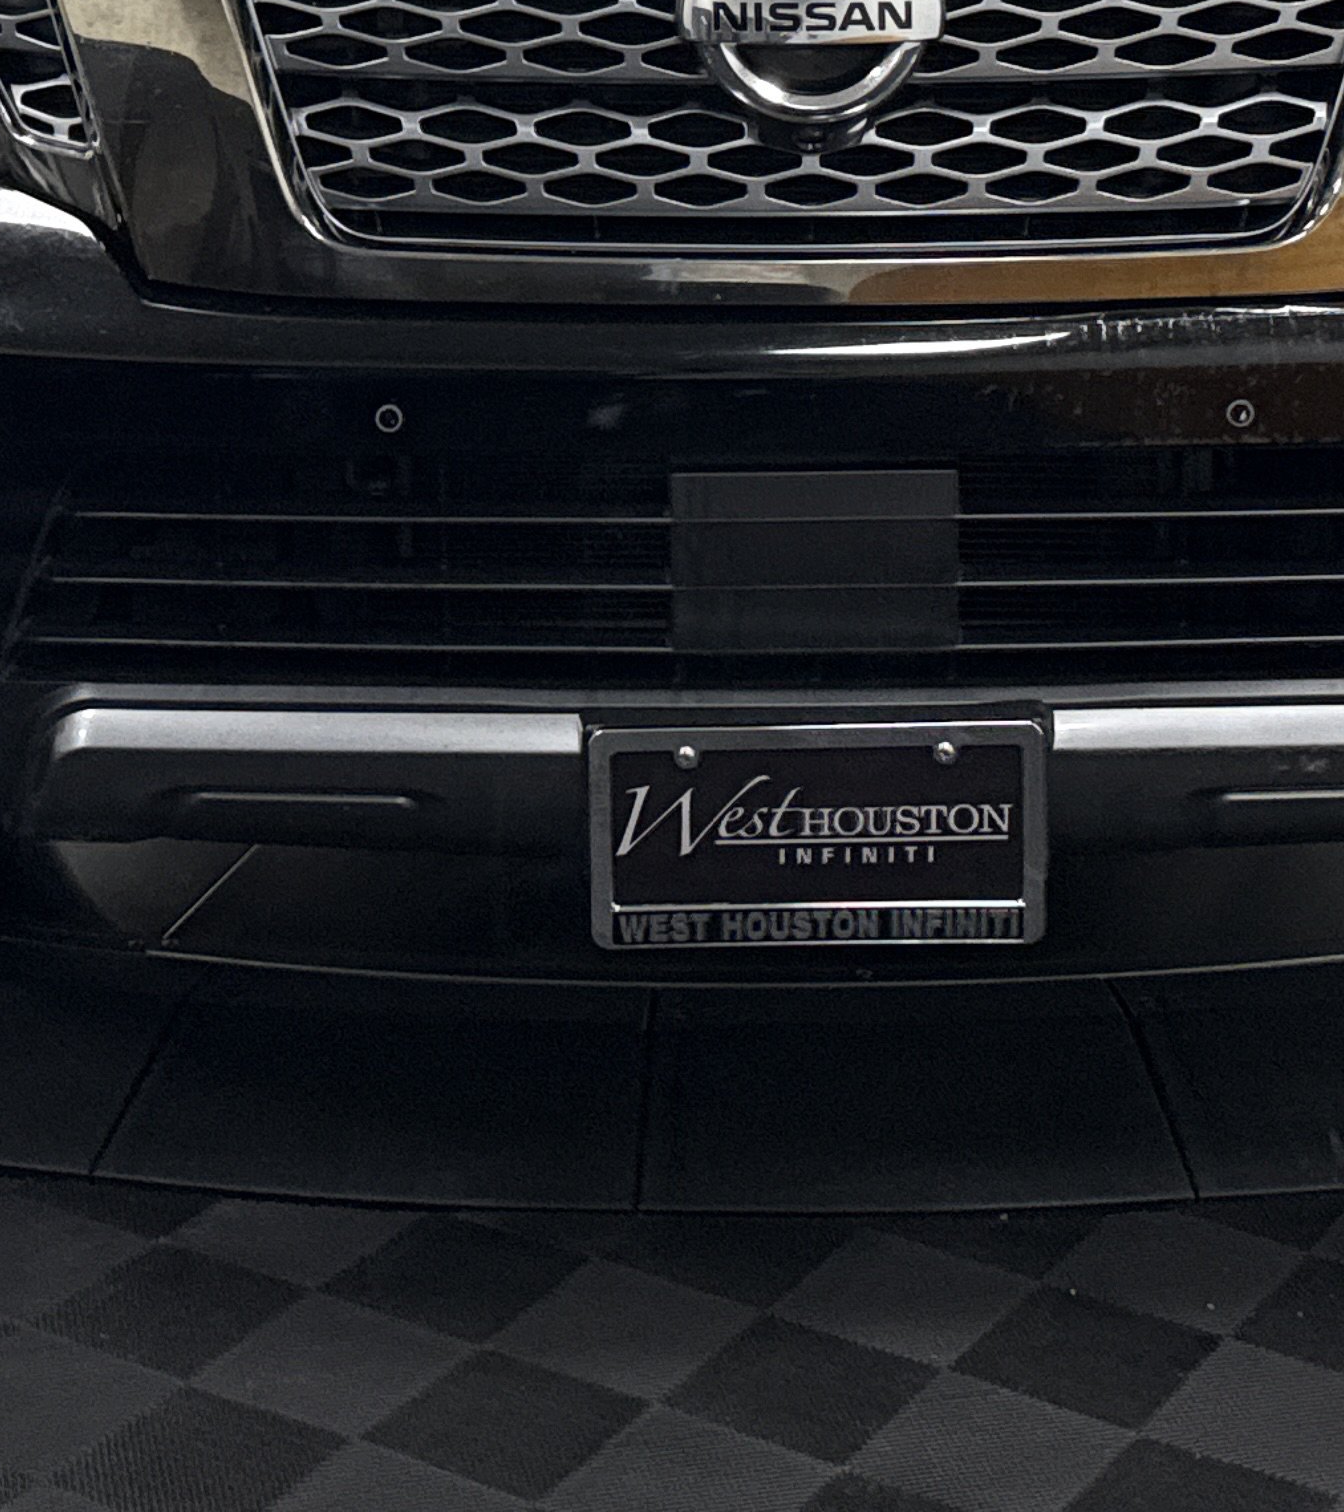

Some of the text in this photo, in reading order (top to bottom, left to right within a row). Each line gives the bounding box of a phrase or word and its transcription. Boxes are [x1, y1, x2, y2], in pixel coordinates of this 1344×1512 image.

[712, 0, 913, 32] NISSAN
[778, 845, 937, 865] INFINITI
[618, 907, 1020, 944] WEST HOUSTON INFINITI
